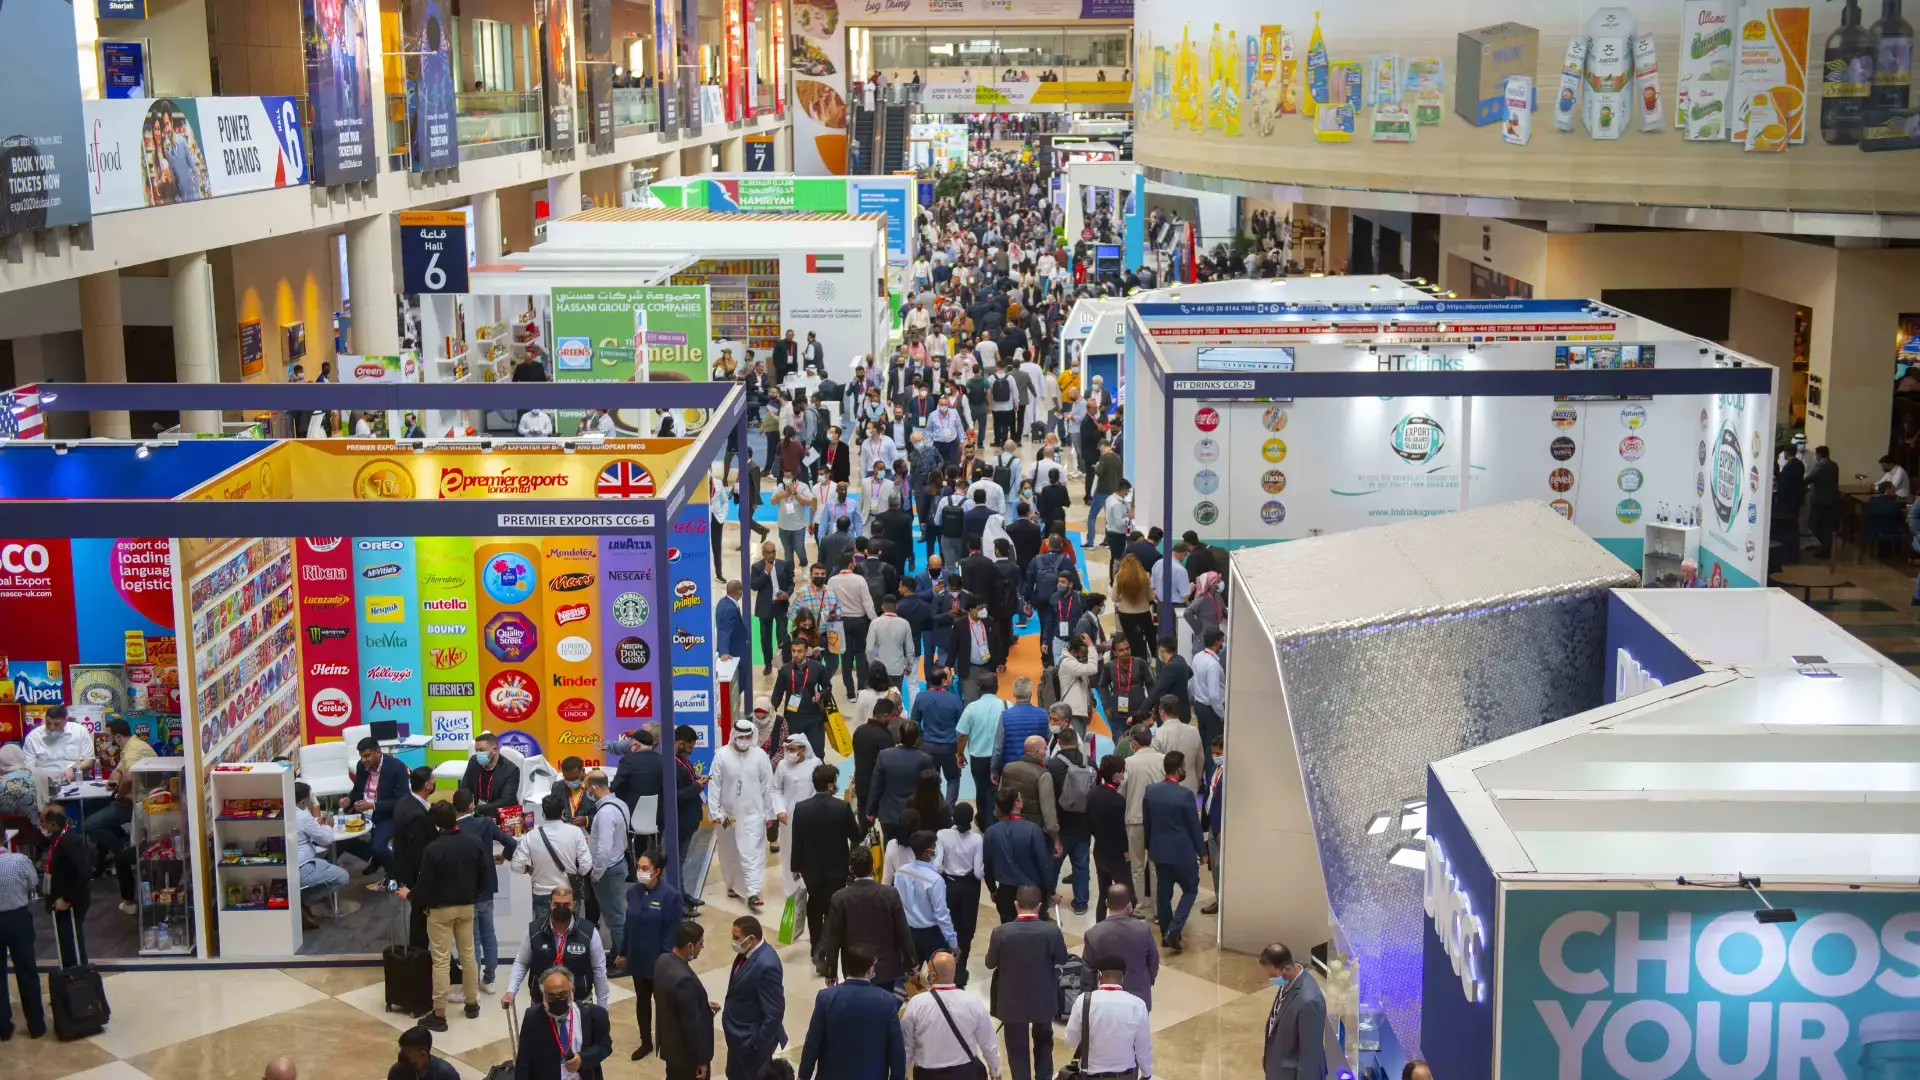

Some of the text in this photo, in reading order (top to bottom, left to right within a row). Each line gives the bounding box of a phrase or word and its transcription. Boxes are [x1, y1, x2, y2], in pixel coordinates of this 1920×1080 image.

[217, 115, 252, 143] POWER
[282, 101, 304, 179] 6
[11, 154, 55, 173] BOOK YOUR
[223, 146, 262, 176] BRANDS
[755, 154, 766, 171] 7
[9, 173, 60, 194] TICKETS NOW
[740, 196, 794, 205] HAMRIYAH
[420, 228, 447, 239] قاعة
[425, 241, 443, 251] Hall
[424, 252, 447, 290] 6
[556, 303, 701, 312] HASSANI GROUP OF COMPANIES
[557, 345, 592, 357] GREEN'S
[1176, 381, 1253, 389] HT DRINKS CCR-25
[1405, 427, 1430, 437] EXPORT
[1404, 442, 1430, 450] GLOBALLY
[1719, 450, 1736, 470] EXPORT
[503, 515, 650, 526] PREMIER EXPORTS CC6-6
[117, 541, 152, 552] export
[358, 540, 404, 550] OREO
[608, 538, 652, 550] LAVAZZA
[302, 565, 347, 581] Ribena
[608, 568, 652, 581] NESCAFÉ
[15, 576, 52, 588] Export
[549, 574, 595, 592] Mars
[303, 595, 343, 605] Lucozade
[423, 599, 468, 611] nutella
[614, 593, 648, 609] STARBUCKS
[673, 595, 702, 614] Pringles
[370, 603, 399, 615] Nesquik
[618, 616, 644, 626] COFFEE
[427, 624, 467, 635] BOUNTY
[496, 629, 525, 639] Quality
[366, 630, 408, 648] belVita
[499, 636, 522, 645] Street
[672, 635, 706, 644] Doritos
[620, 649, 646, 658] Dolce
[621, 656, 646, 664] Gusto
[311, 663, 350, 676] Heinz
[367, 665, 413, 682] Kellogg's
[15, 681, 62, 704] Alpen
[429, 683, 474, 696] HERSHEY'S
[369, 690, 412, 711] Alpen
[618, 686, 650, 713] illy
[674, 700, 706, 709] Aptamil
[317, 704, 347, 713] Cerelac
[434, 716, 470, 733] Ritter
[435, 732, 470, 741] SPORT
[1539, 910, 1920, 998] CHOOS
[1532, 1000, 1851, 1080] YOUR
